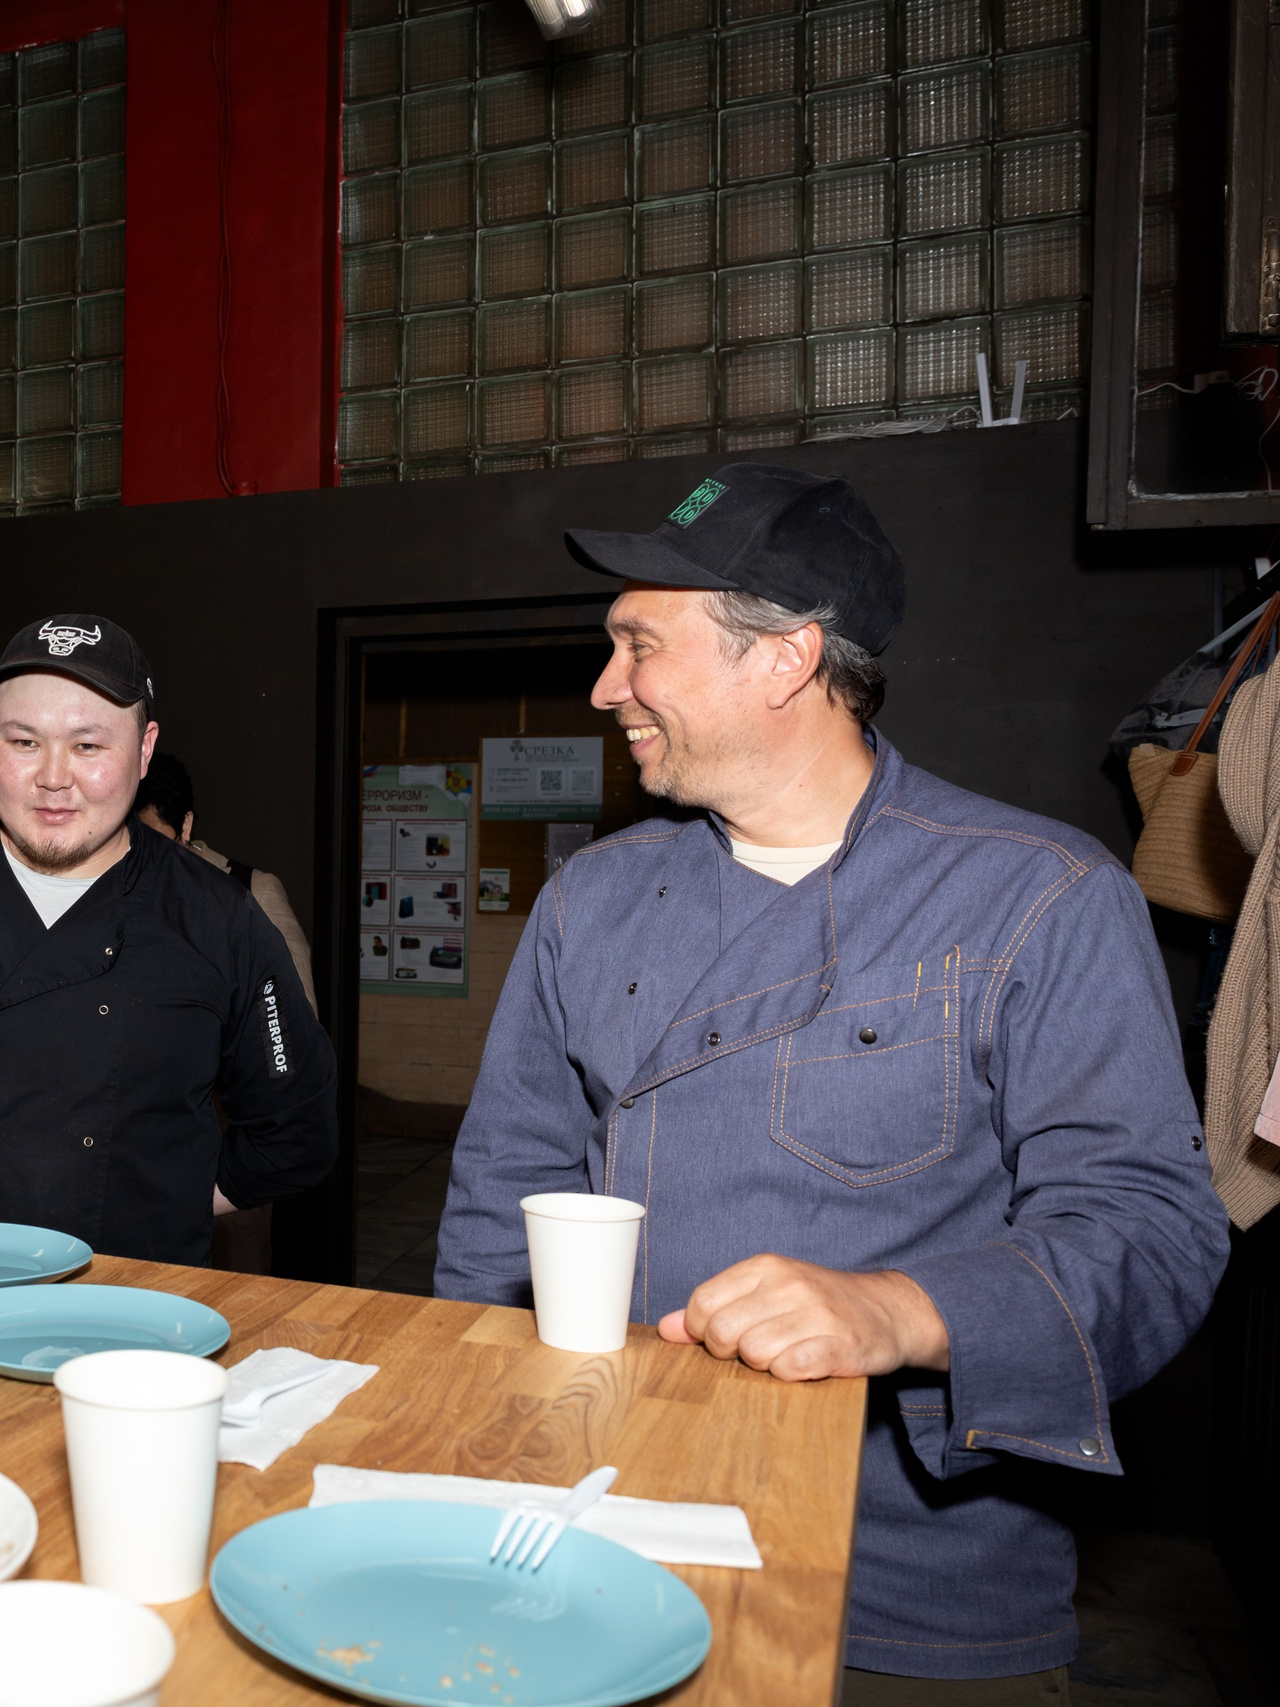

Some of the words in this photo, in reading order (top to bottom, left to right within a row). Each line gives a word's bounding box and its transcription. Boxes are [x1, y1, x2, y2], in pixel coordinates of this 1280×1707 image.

[524, 746, 574, 755] СРЕЗКА
[362, 790, 422, 801] ЕРРОРИЗМ
[362, 804, 381, 812] РОЗА
[386, 804, 429, 812] ОБЩЕСТВУ
[264, 995, 287, 1073] PITERPROF
